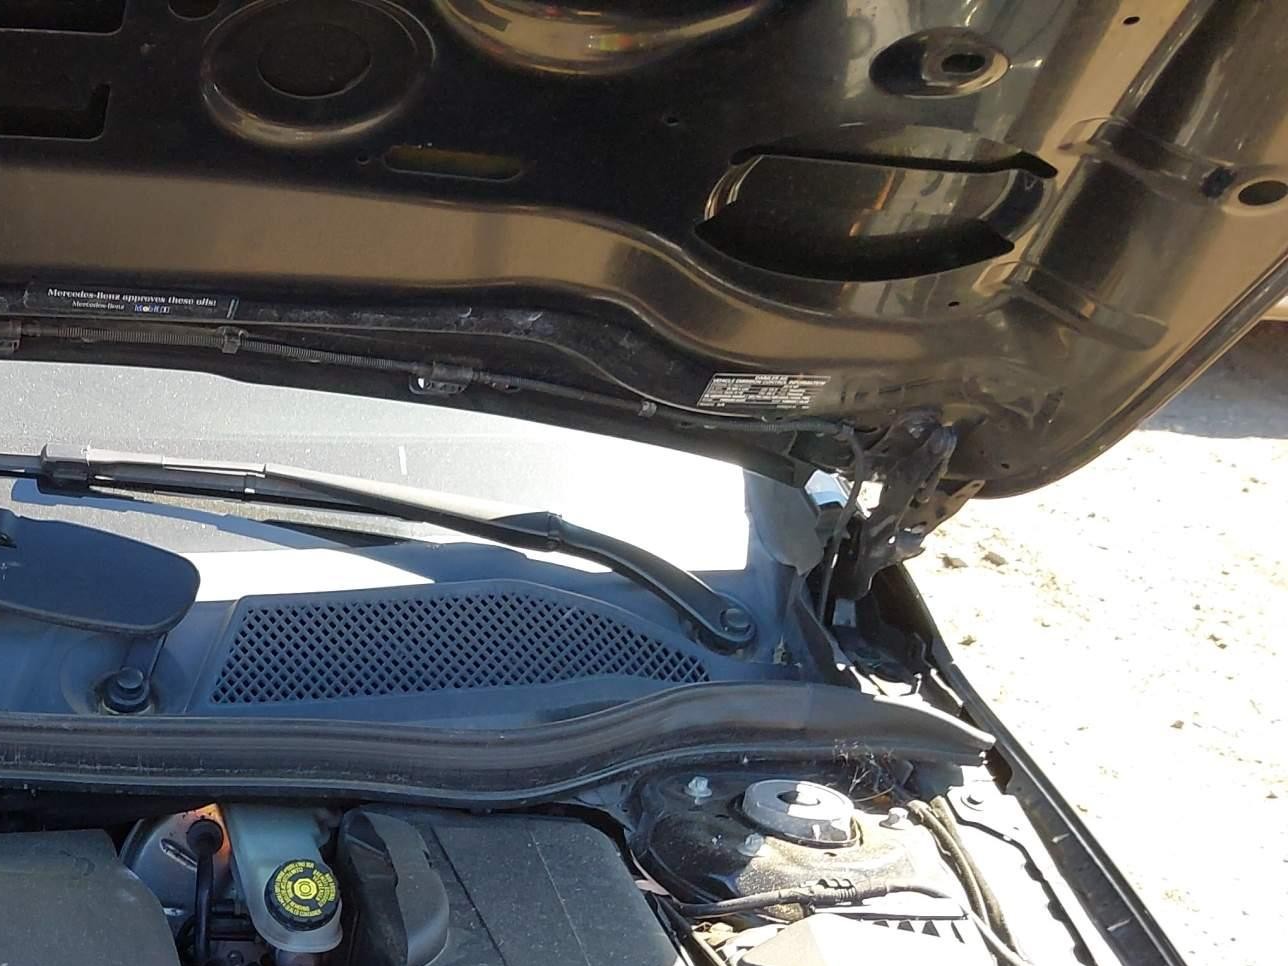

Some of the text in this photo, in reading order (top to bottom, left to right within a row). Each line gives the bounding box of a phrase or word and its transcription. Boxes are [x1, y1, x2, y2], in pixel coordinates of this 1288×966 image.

[47, 288, 120, 301] Mercedes-Benz
[122, 294, 165, 304] approves
[168, 295, 194, 305] these
